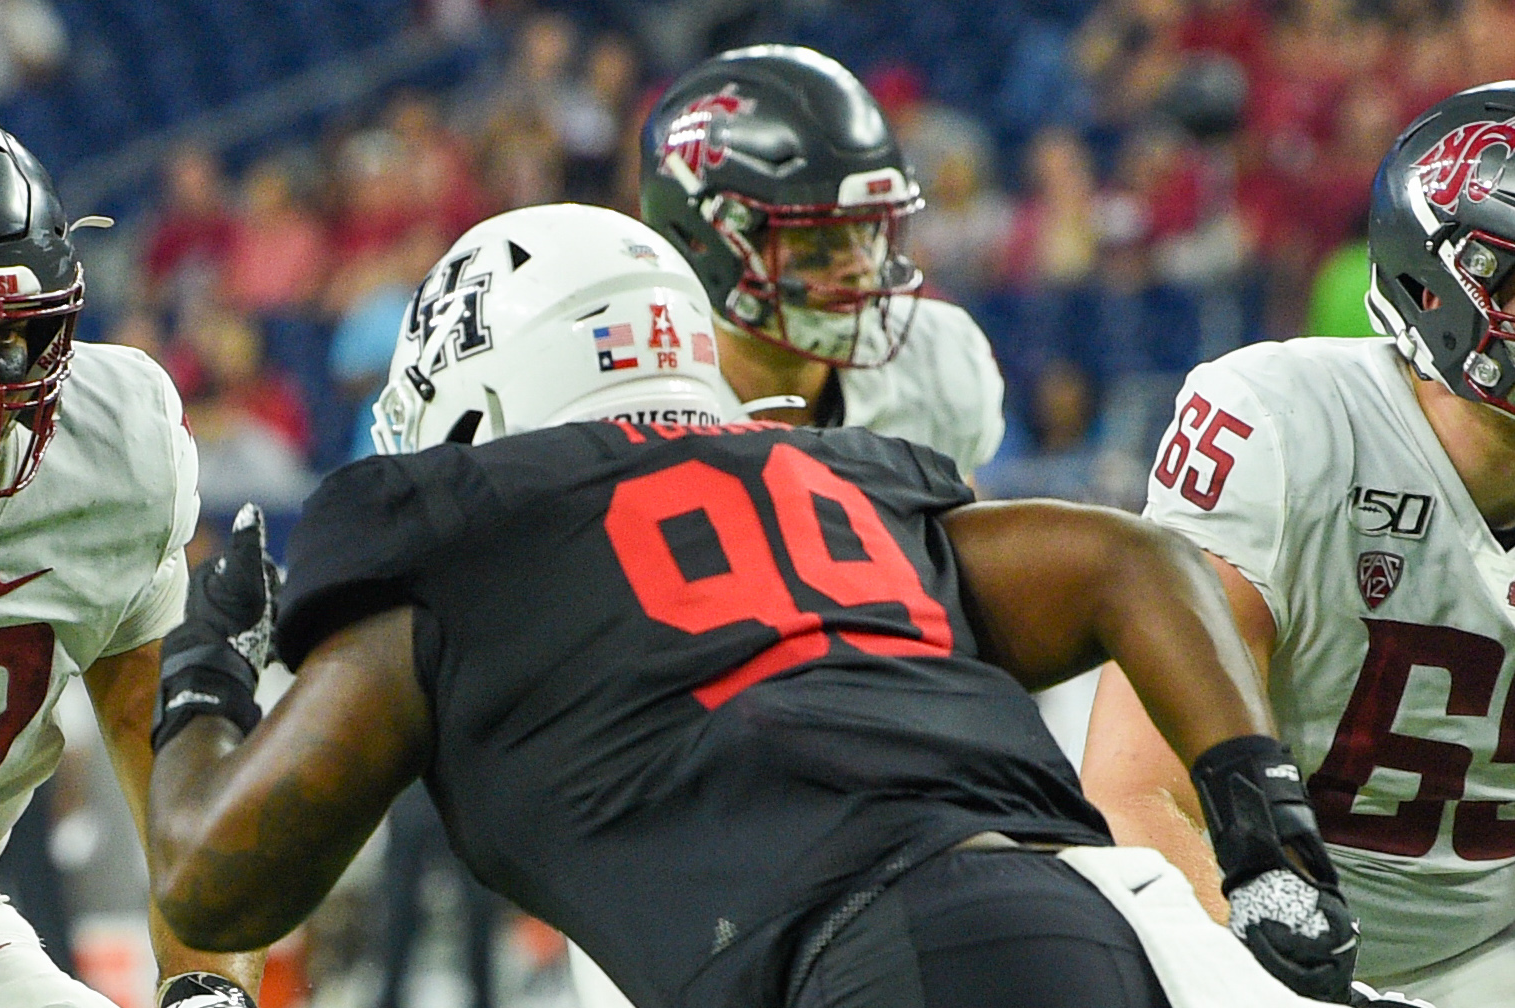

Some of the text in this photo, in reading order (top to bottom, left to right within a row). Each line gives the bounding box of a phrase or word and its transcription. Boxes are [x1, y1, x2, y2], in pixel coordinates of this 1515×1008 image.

[657, 351, 678, 369] P6
[1154, 391, 1255, 512] 65
[1348, 486, 1432, 534] 150
[603, 441, 954, 711] 99
[1359, 554, 1401, 588] PAC
[1366, 576, 1387, 599] 12
